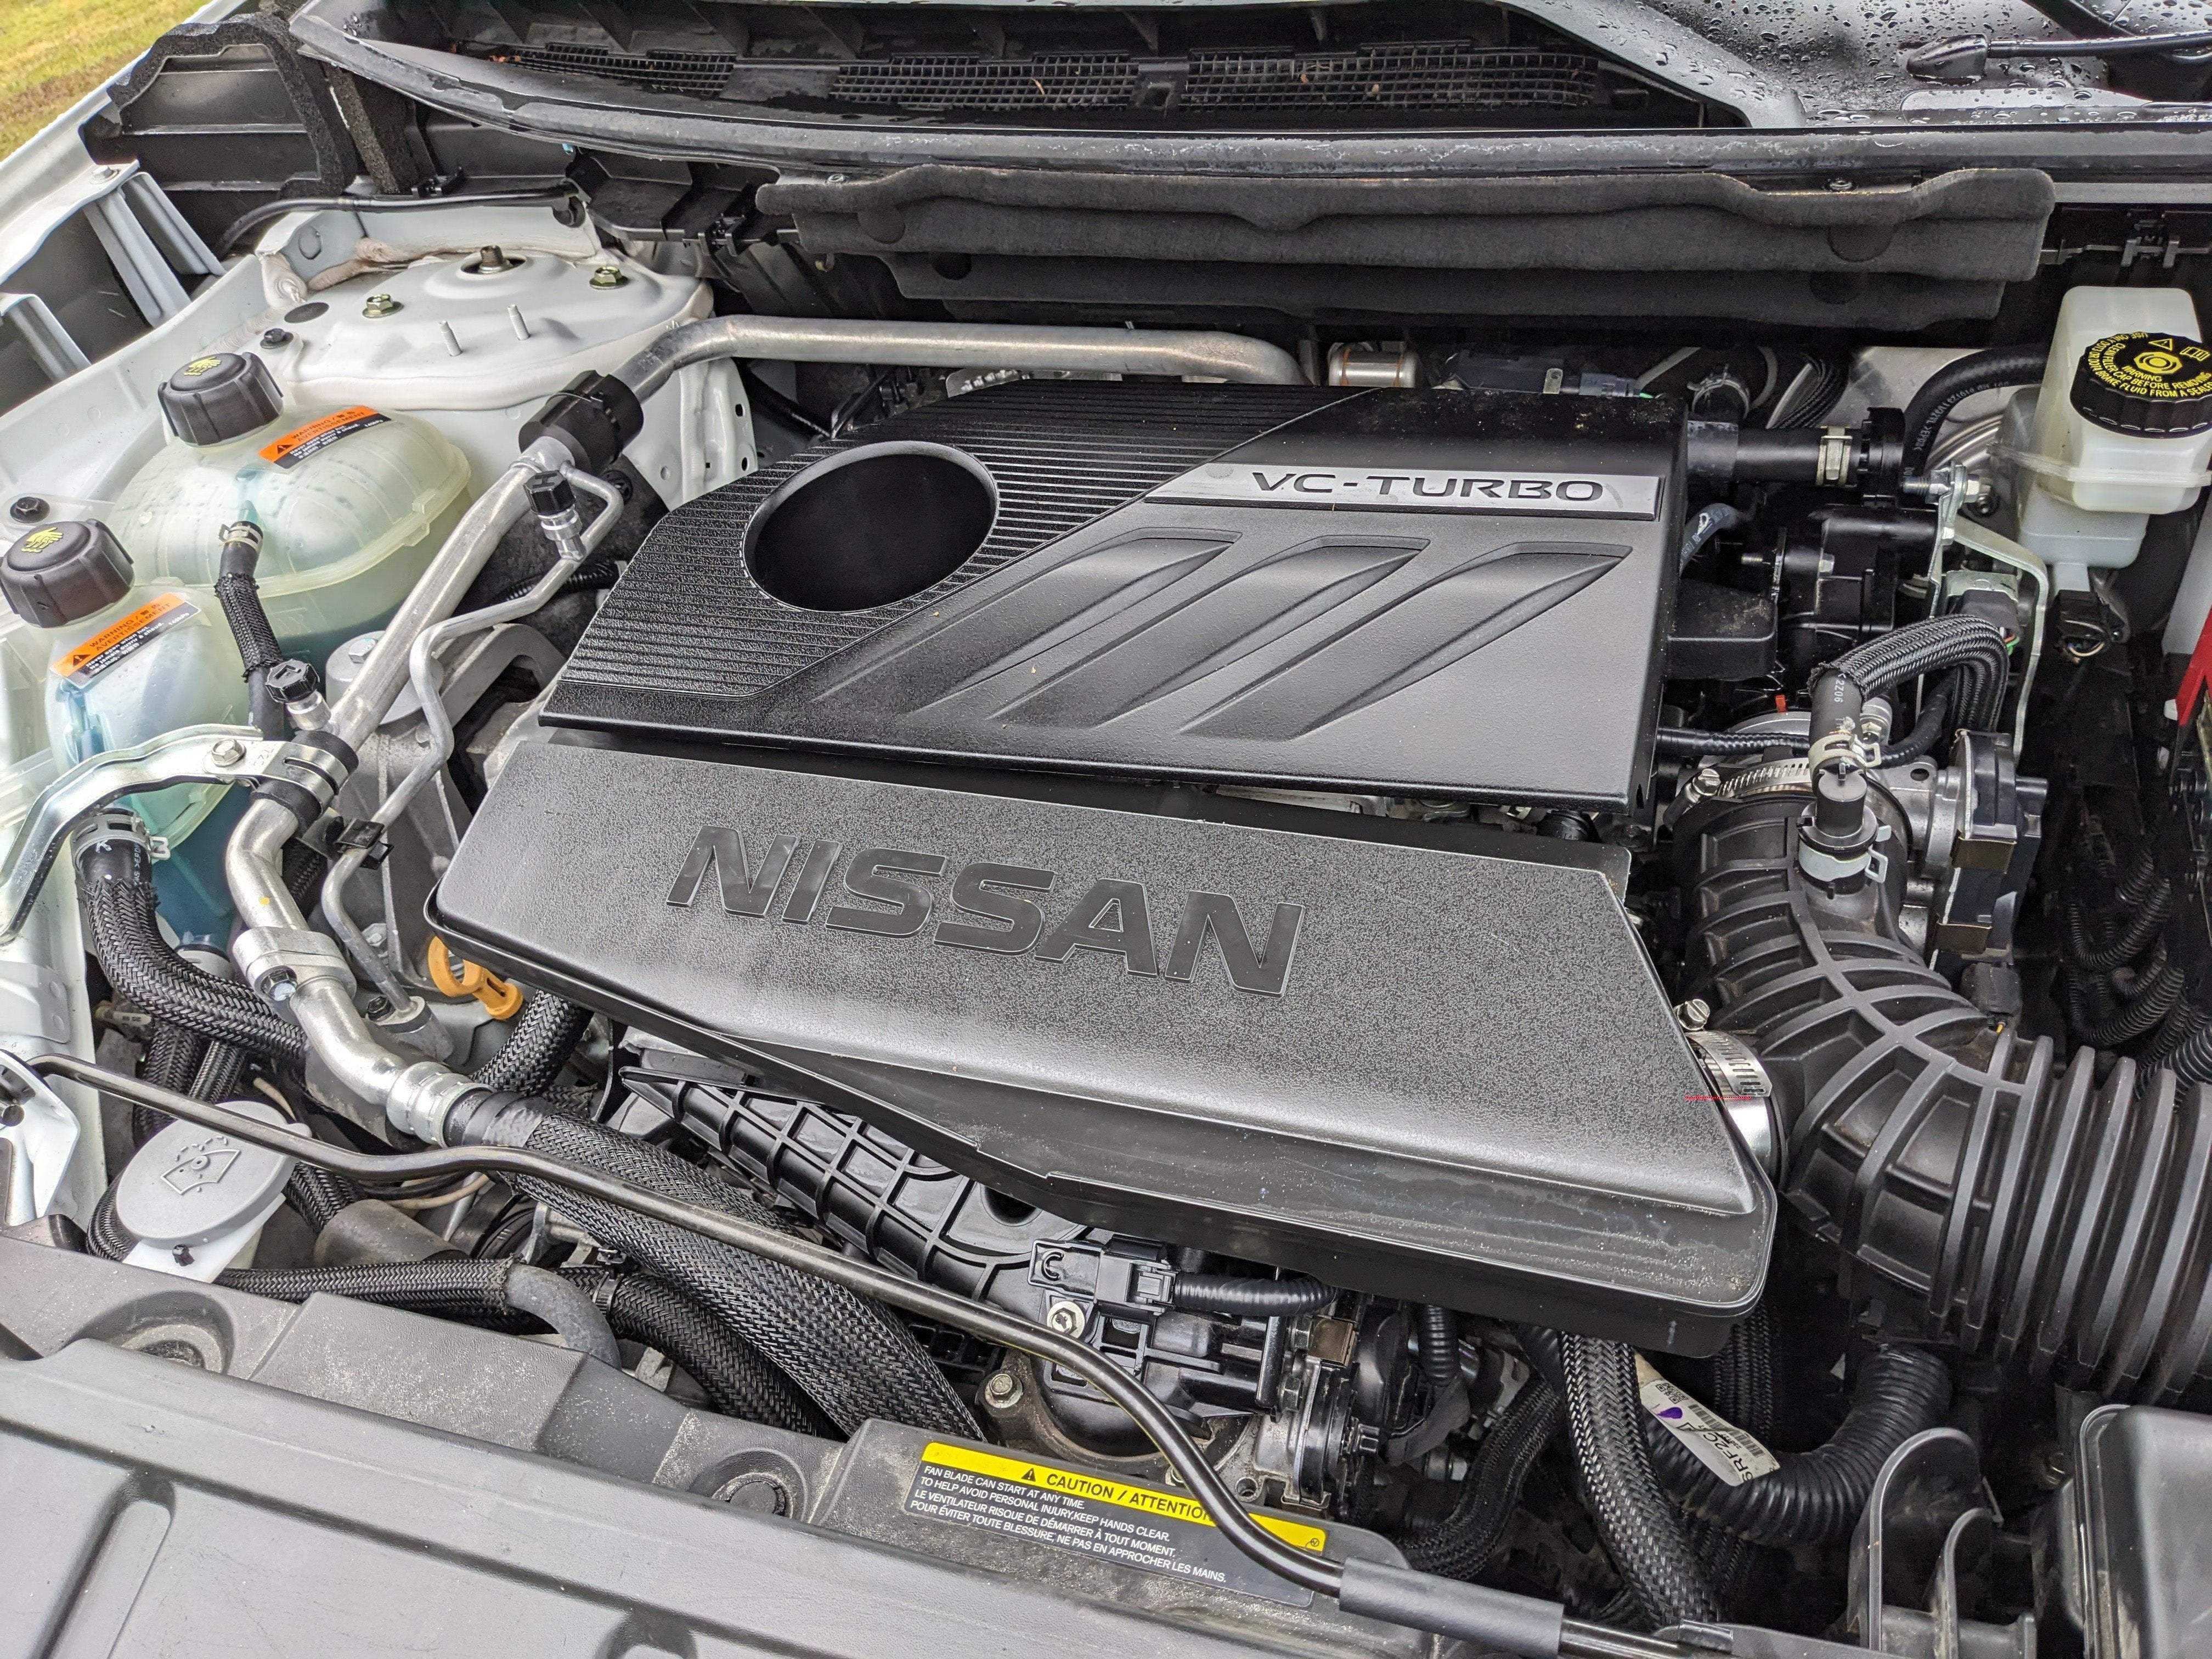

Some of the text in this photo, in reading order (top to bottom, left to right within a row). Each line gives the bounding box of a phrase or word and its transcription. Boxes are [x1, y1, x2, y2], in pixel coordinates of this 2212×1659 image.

[2103, 343, 2126, 356] CLEAN
[2107, 334, 2129, 344] ONLY
[2095, 370, 2121, 387] BRAKE
[2113, 371, 2132, 381] CAP
[2121, 365, 2163, 382] WARNING
[2131, 379, 2171, 391] BEFORE
[2172, 371, 2211, 390] REMOVING
[2119, 383, 2147, 394] FLUID
[1252, 471, 1602, 502] VC-TURBO
[89, 619, 134, 647] WARNING
[96, 603, 171, 651] AVERTISSEMENT
[86, 654, 104, 667] Never
[105, 644, 120, 655] open
[121, 634, 137, 644] when
[100, 650, 120, 664] jamais
[120, 639, 138, 650] ouvrir
[144, 622, 164, 636] chaud.
[666, 825, 1305, 998] NISSAN
[924, 1466, 1085, 1510] FAN BLADE CAN START AT ANY TIME.
[1047, 1474, 1114, 1498] CAUTION
[1118, 1490, 1127, 1500] /
[915, 1489, 1176, 1557] LE VENTILATEUR RISQUE DE DÉMARRER À TOUT MOMENT.
[921, 1477, 934, 1487] TO
[935, 1480, 959, 1492] HELP
[959, 1486, 988, 1499] AVOID
[989, 1492, 1040, 1511] PERSONAL
[1100, 1519, 1135, 1533] HANDS
[1136, 1527, 1170, 1542] CLEAR.
[910, 1500, 938, 1514] POUR
[939, 1505, 970, 1521] ÉVITER
[972, 1515, 1001, 1529] TOUTE
[1057, 1535, 1070, 1546] NE
[1072, 1538, 1092, 1550] PAS
[1093, 1543, 1108, 1554] EN
[1108, 1547, 1171, 1570] APPROCHER
[1171, 1562, 1191, 1574] LES
[1192, 1567, 1226, 1583] MAINS.
